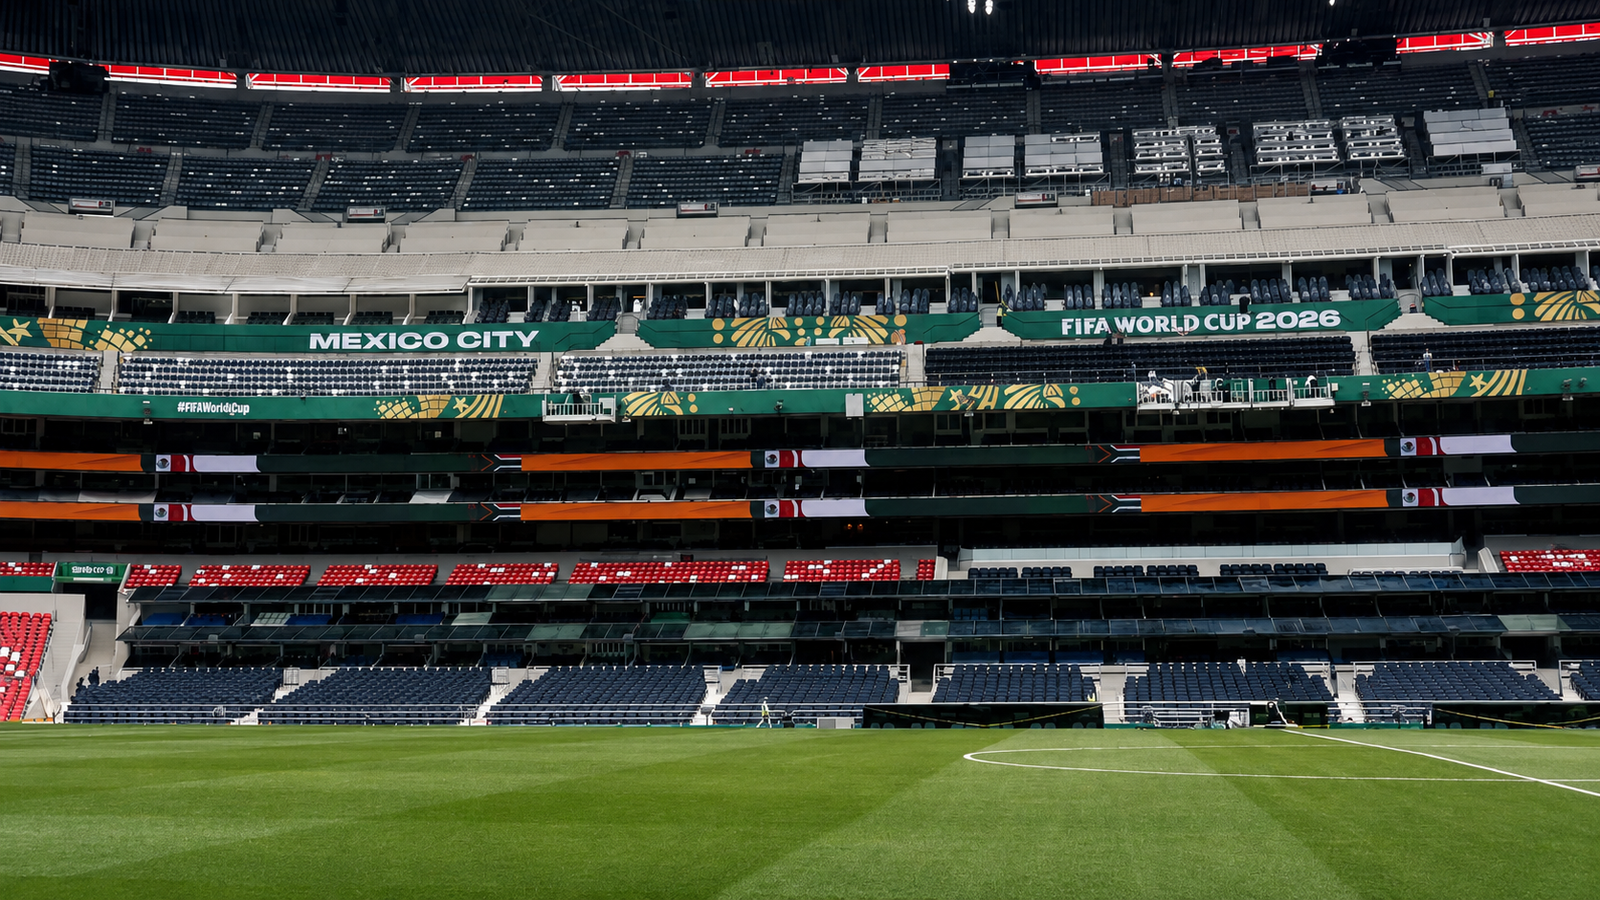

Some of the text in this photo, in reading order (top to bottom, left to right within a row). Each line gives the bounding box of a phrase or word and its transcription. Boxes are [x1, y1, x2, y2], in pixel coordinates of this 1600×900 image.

[1061, 309, 1341, 335] FIFA WORLD CUP 2026
[309, 330, 540, 350] MEXICO CITY
[177, 401, 250, 416] #FIFAWorldCup
